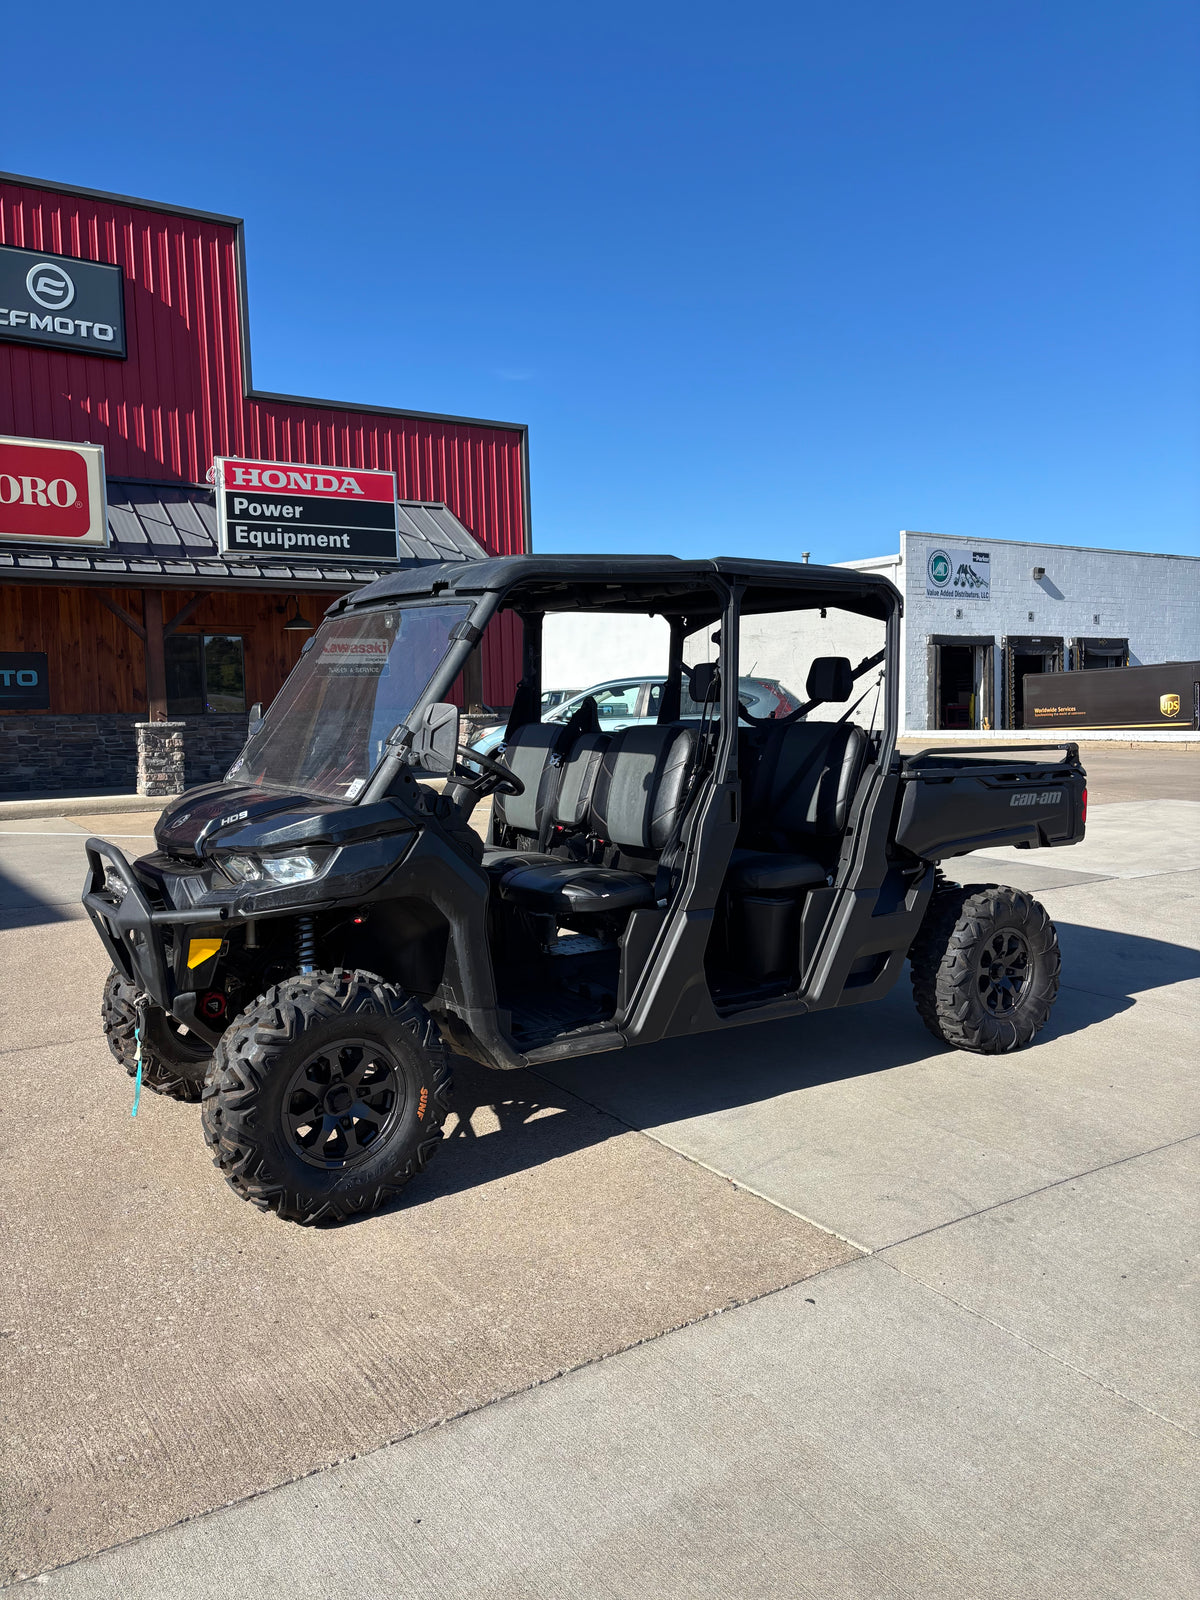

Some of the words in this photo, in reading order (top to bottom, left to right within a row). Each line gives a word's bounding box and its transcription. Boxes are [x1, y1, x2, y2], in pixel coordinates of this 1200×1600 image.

[232, 467, 365, 495] HONDA
[234, 497, 303, 518] Power
[235, 526, 350, 549] Equipment
[955, 590, 979, 598] Distributors,
[1161, 700, 1179, 714] ups
[1010, 791, 1062, 807] can-am
[221, 810, 248, 826] HD9
[416, 1085, 428, 1121] SUNF
